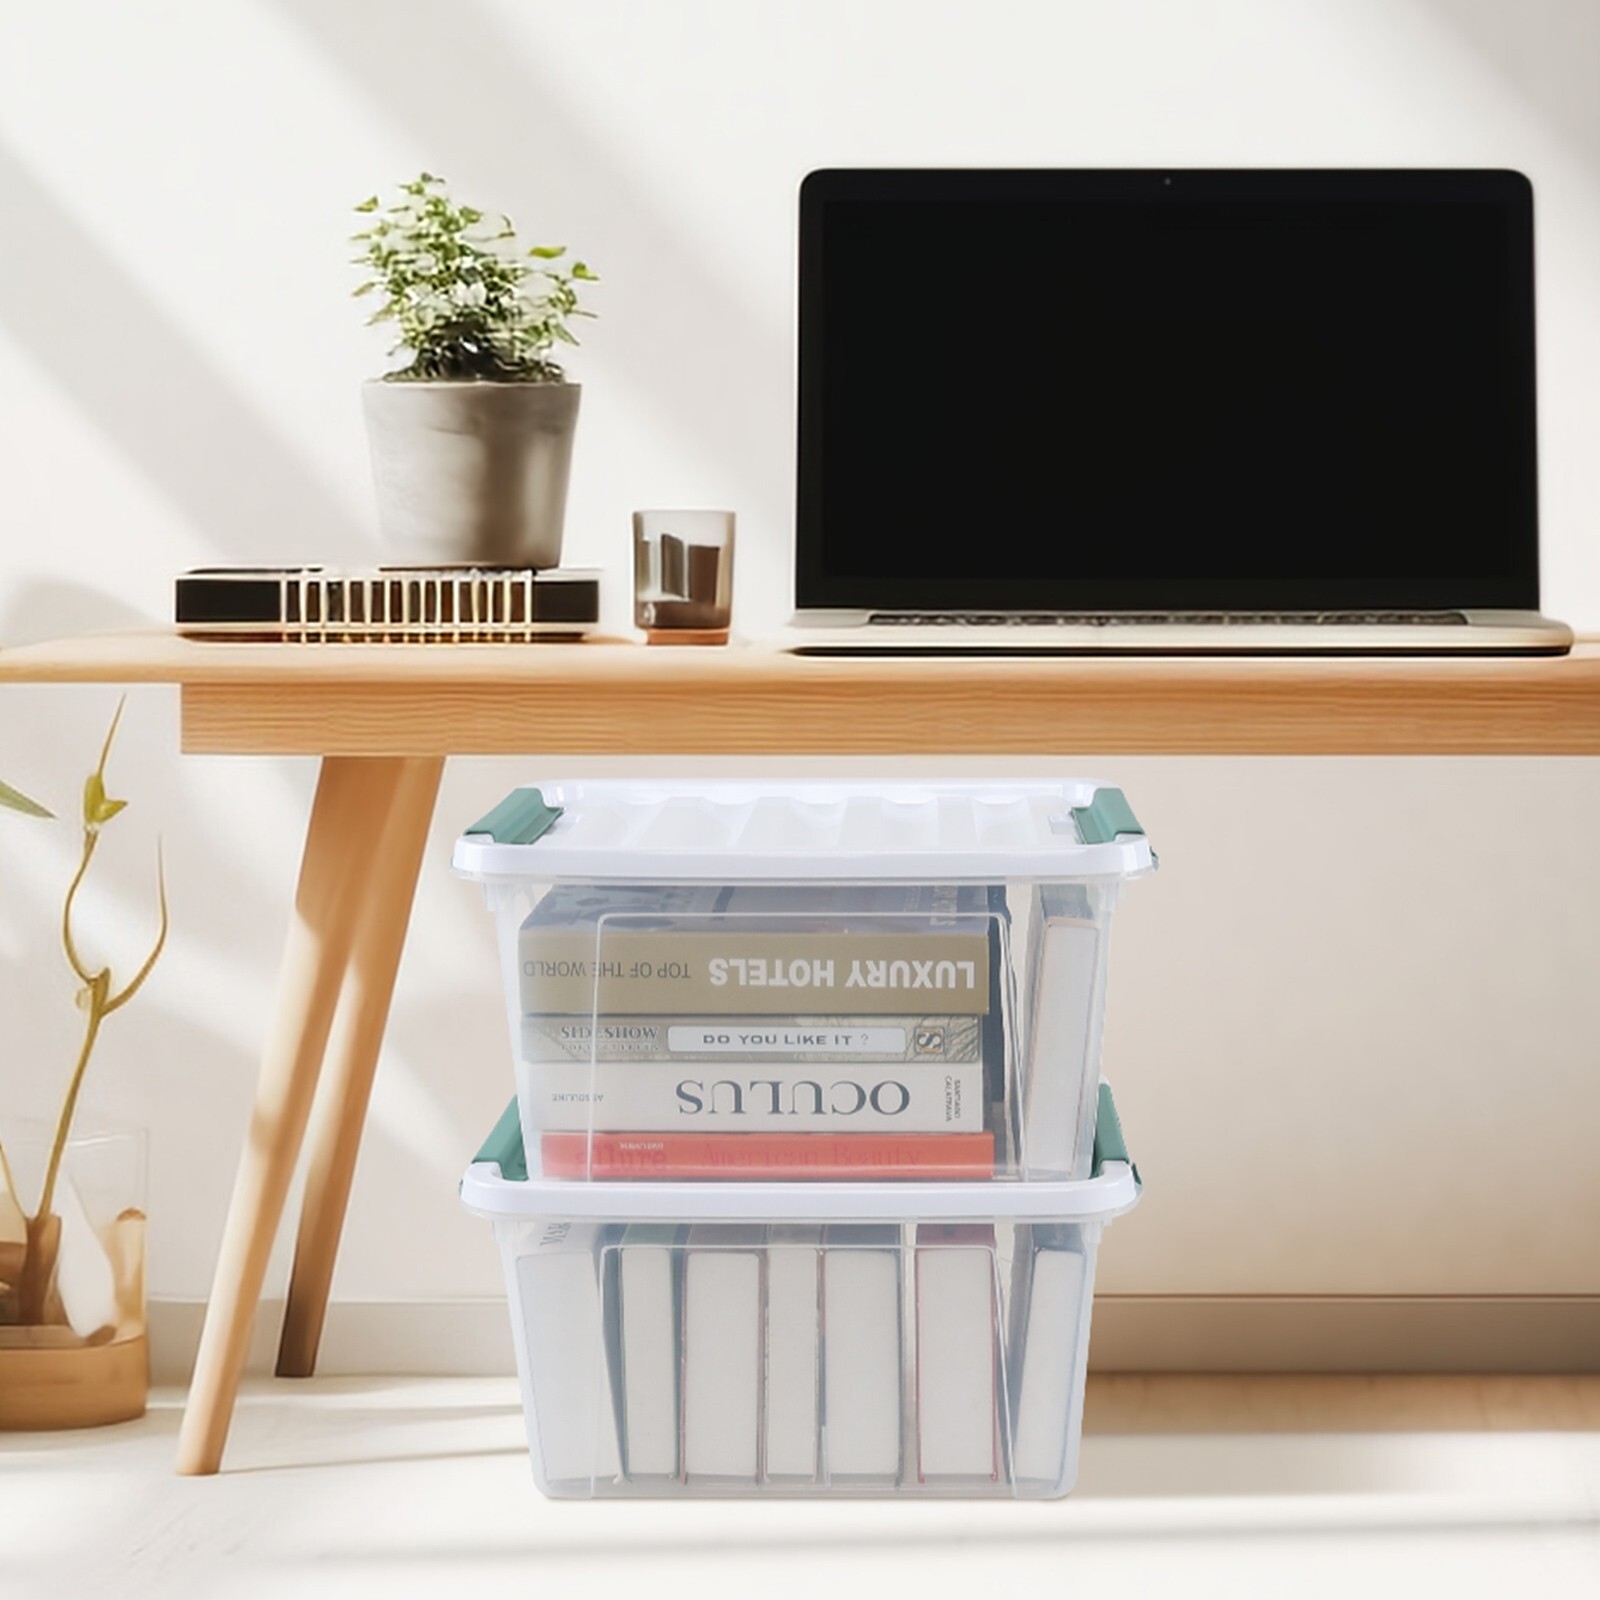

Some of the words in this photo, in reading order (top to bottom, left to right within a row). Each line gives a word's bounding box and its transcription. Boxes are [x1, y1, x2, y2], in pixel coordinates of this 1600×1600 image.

[523, 960, 586, 977] WORLD
[591, 961, 624, 978] THE
[629, 961, 653, 979] OF
[657, 961, 691, 979] TOP
[709, 958, 835, 987] HOTELS
[845, 960, 975, 988] LUXURY
[703, 1034, 731, 1044] DO
[739, 1034, 777, 1045] YOU
[784, 1034, 827, 1045] LIKE
[834, 1034, 854, 1045] IT
[676, 1079, 911, 1116] OCULUS
